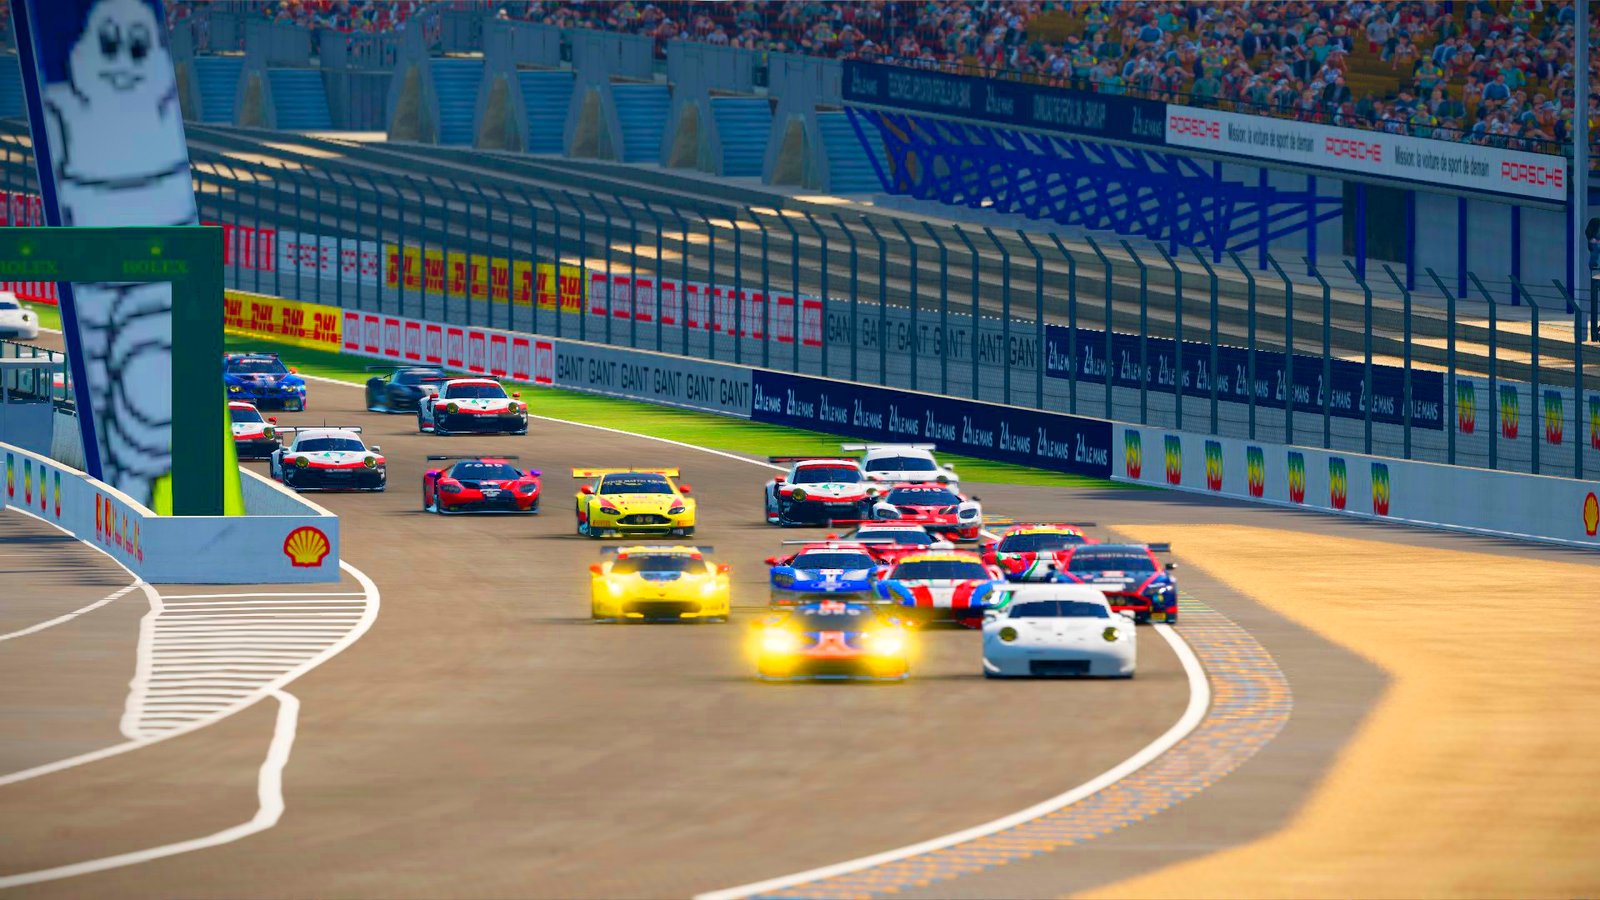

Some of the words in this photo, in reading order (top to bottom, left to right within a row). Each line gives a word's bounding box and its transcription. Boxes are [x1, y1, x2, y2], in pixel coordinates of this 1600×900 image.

[1170, 116, 1220, 140] PORSCHE
[1326, 137, 1382, 162] PORSCHE
[1422, 150, 1439, 170] voiture
[1440, 152, 1447, 172] de
[1448, 156, 1462, 176] sport
[1463, 154, 1469, 174] de
[1470, 156, 1489, 177] demain
[1502, 162, 1562, 188] PORSCHE
[313, 312, 338, 343] DHL
[980, 332, 1002, 364] ANT
[558, 354, 584, 382] GANT
[589, 359, 616, 387] GANT
[621, 364, 649, 392] GANT
[654, 368, 682, 397] GANT
[686, 373, 715, 402] GANT
[720, 378, 749, 408] GANT
[763, 397, 769, 412] LE
[769, 398, 782, 412] MANS
[795, 400, 801, 416] LE
[802, 401, 814, 418] MANS
[828, 405, 834, 422] LE
[834, 406, 848, 424] MANS
[1421, 400, 1438, 420] MANS
[863, 410, 868, 427] LE
[869, 412, 882, 430] MANS
[898, 416, 904, 432] LE
[905, 418, 918, 436] MANS
[935, 422, 941, 440] LE
[942, 424, 956, 441] MANS
[972, 428, 978, 445] LE
[978, 430, 993, 448] MANS
[1010, 434, 1016, 451] LE
[1016, 436, 1030, 453] MANS
[1048, 440, 1054, 457] LE
[1054, 441, 1068, 460] MANS
[1086, 446, 1092, 463] LE
[1092, 446, 1108, 466] MANS
